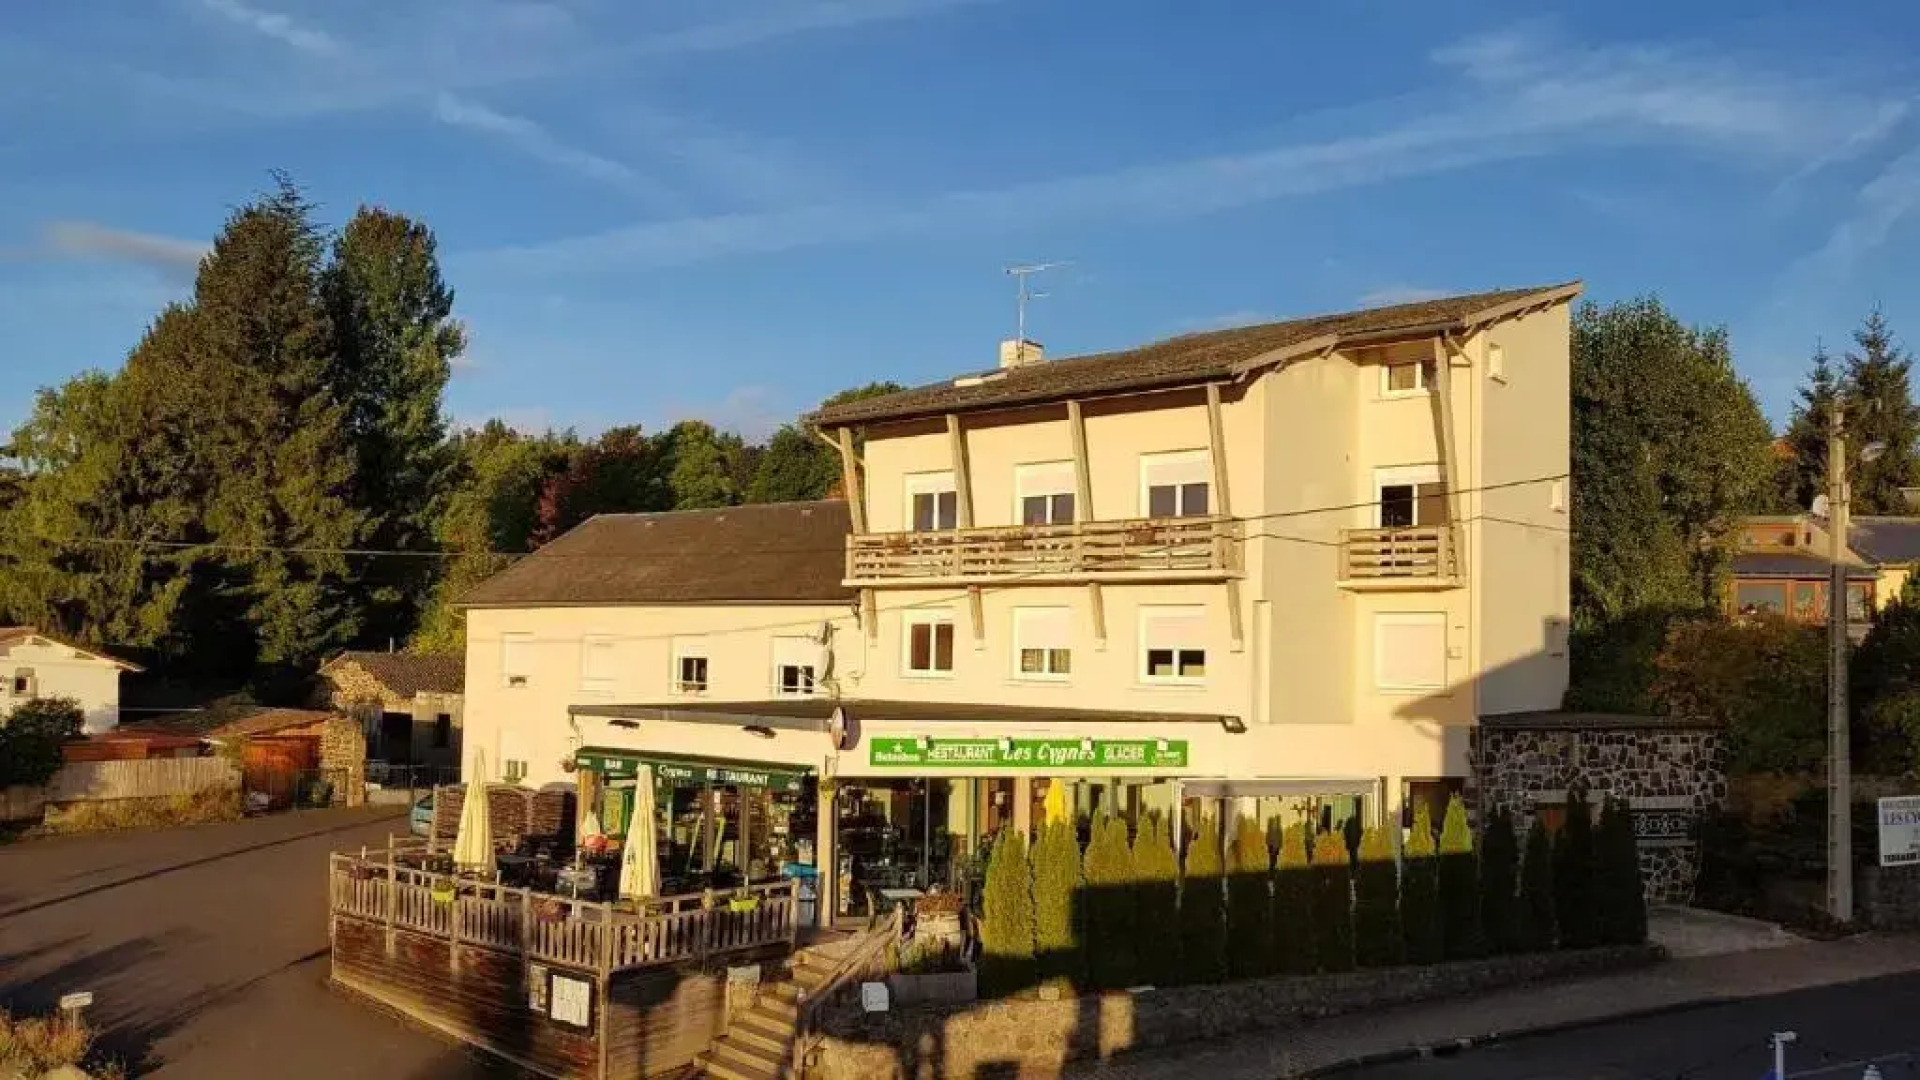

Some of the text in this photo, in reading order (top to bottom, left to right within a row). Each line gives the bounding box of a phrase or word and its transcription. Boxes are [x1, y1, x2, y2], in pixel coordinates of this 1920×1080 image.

[926, 744, 996, 760] RESTAURANT
[1002, 743, 1096, 765] Les Cygnes
[1103, 746, 1145, 760] GLACIER
